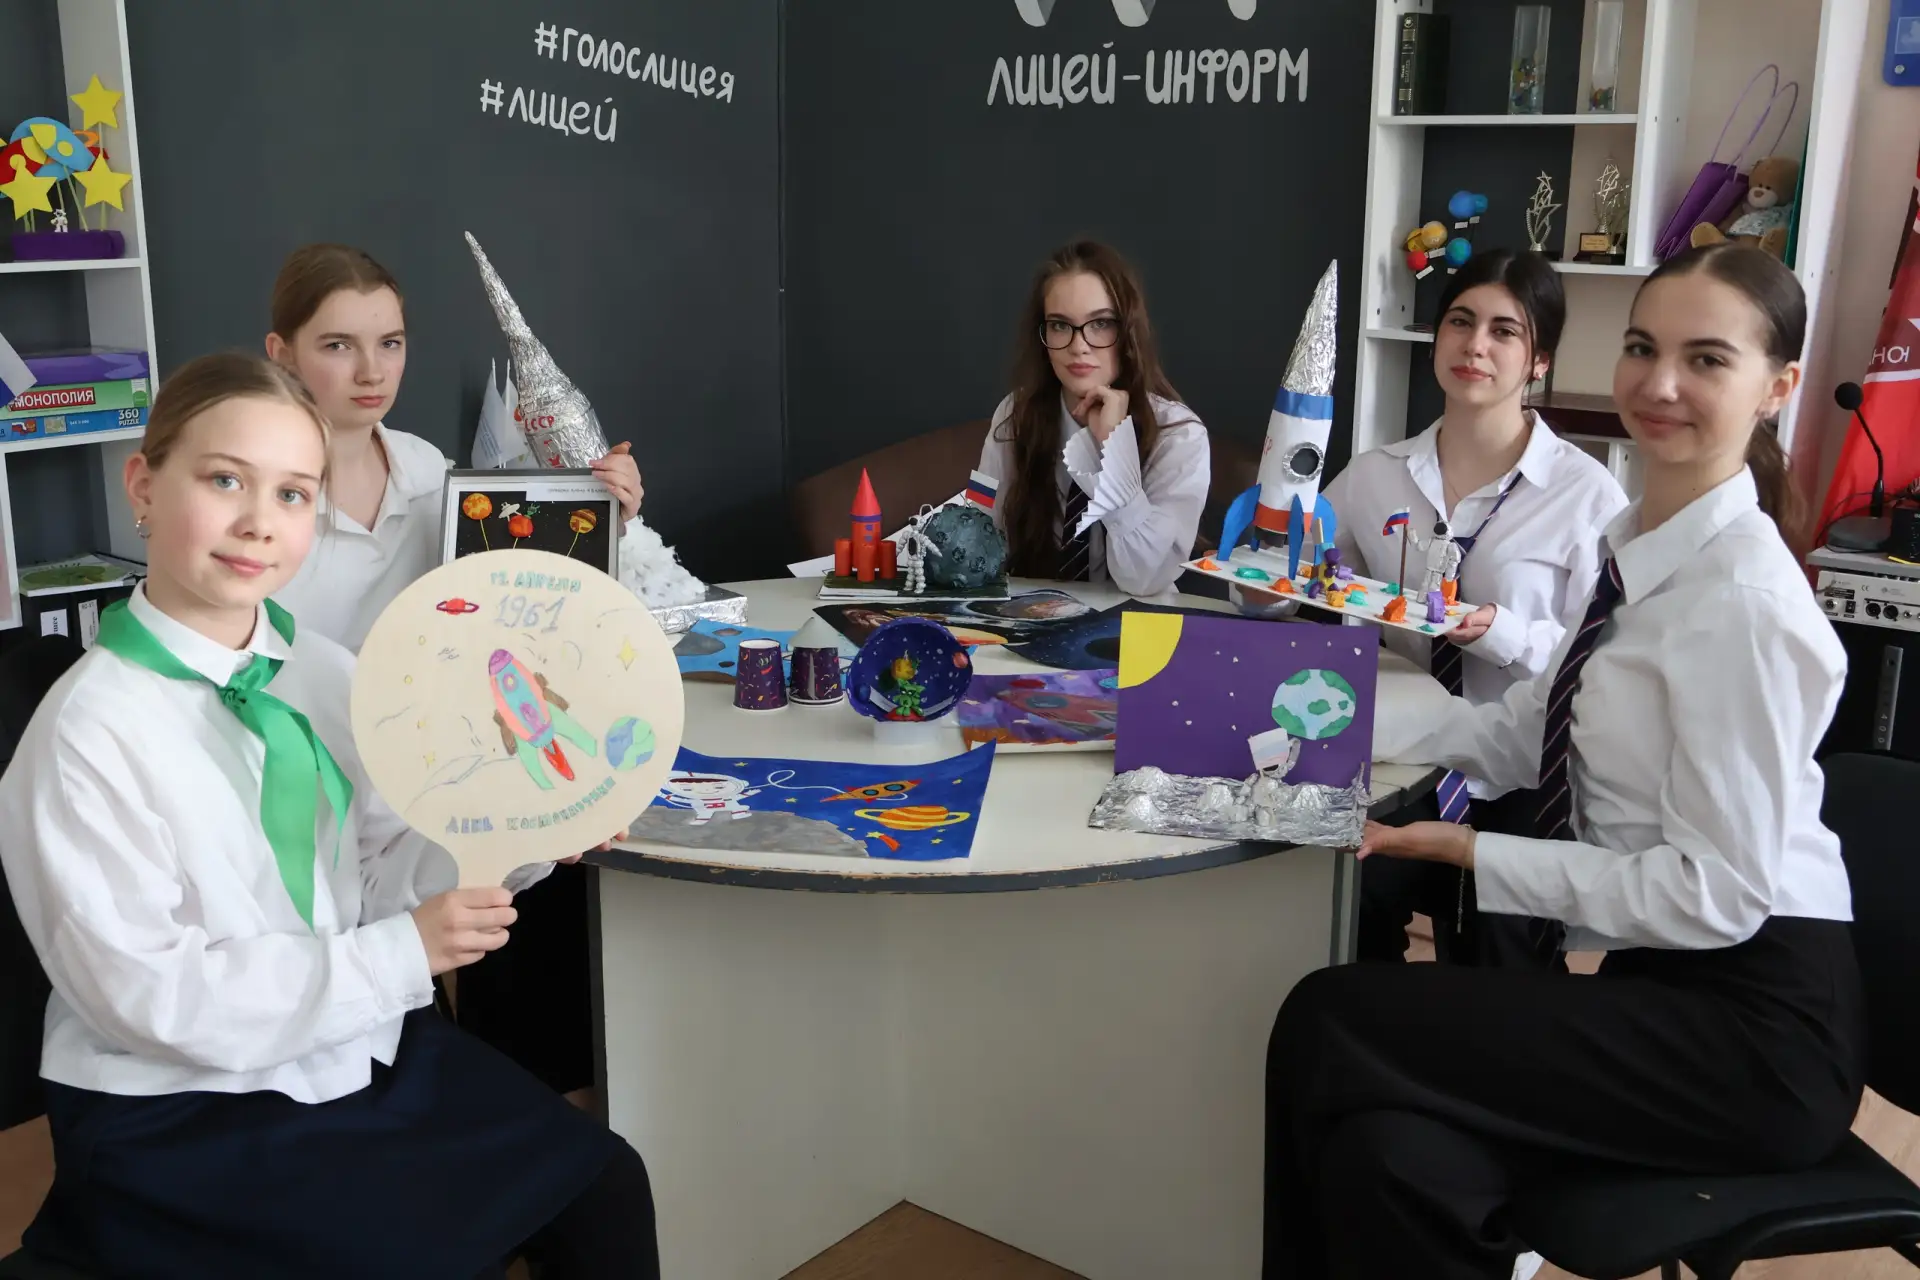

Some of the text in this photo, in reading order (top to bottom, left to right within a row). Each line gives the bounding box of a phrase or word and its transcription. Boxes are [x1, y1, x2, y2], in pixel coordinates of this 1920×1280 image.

[15, 389, 94, 408] МОНОПОЛИЯ
[117, 407, 140, 420] 360
[118, 418, 140, 427] PUZZLE
[494, 594, 566, 633] 1961
[445, 816, 494, 834] ДЕНЬ
